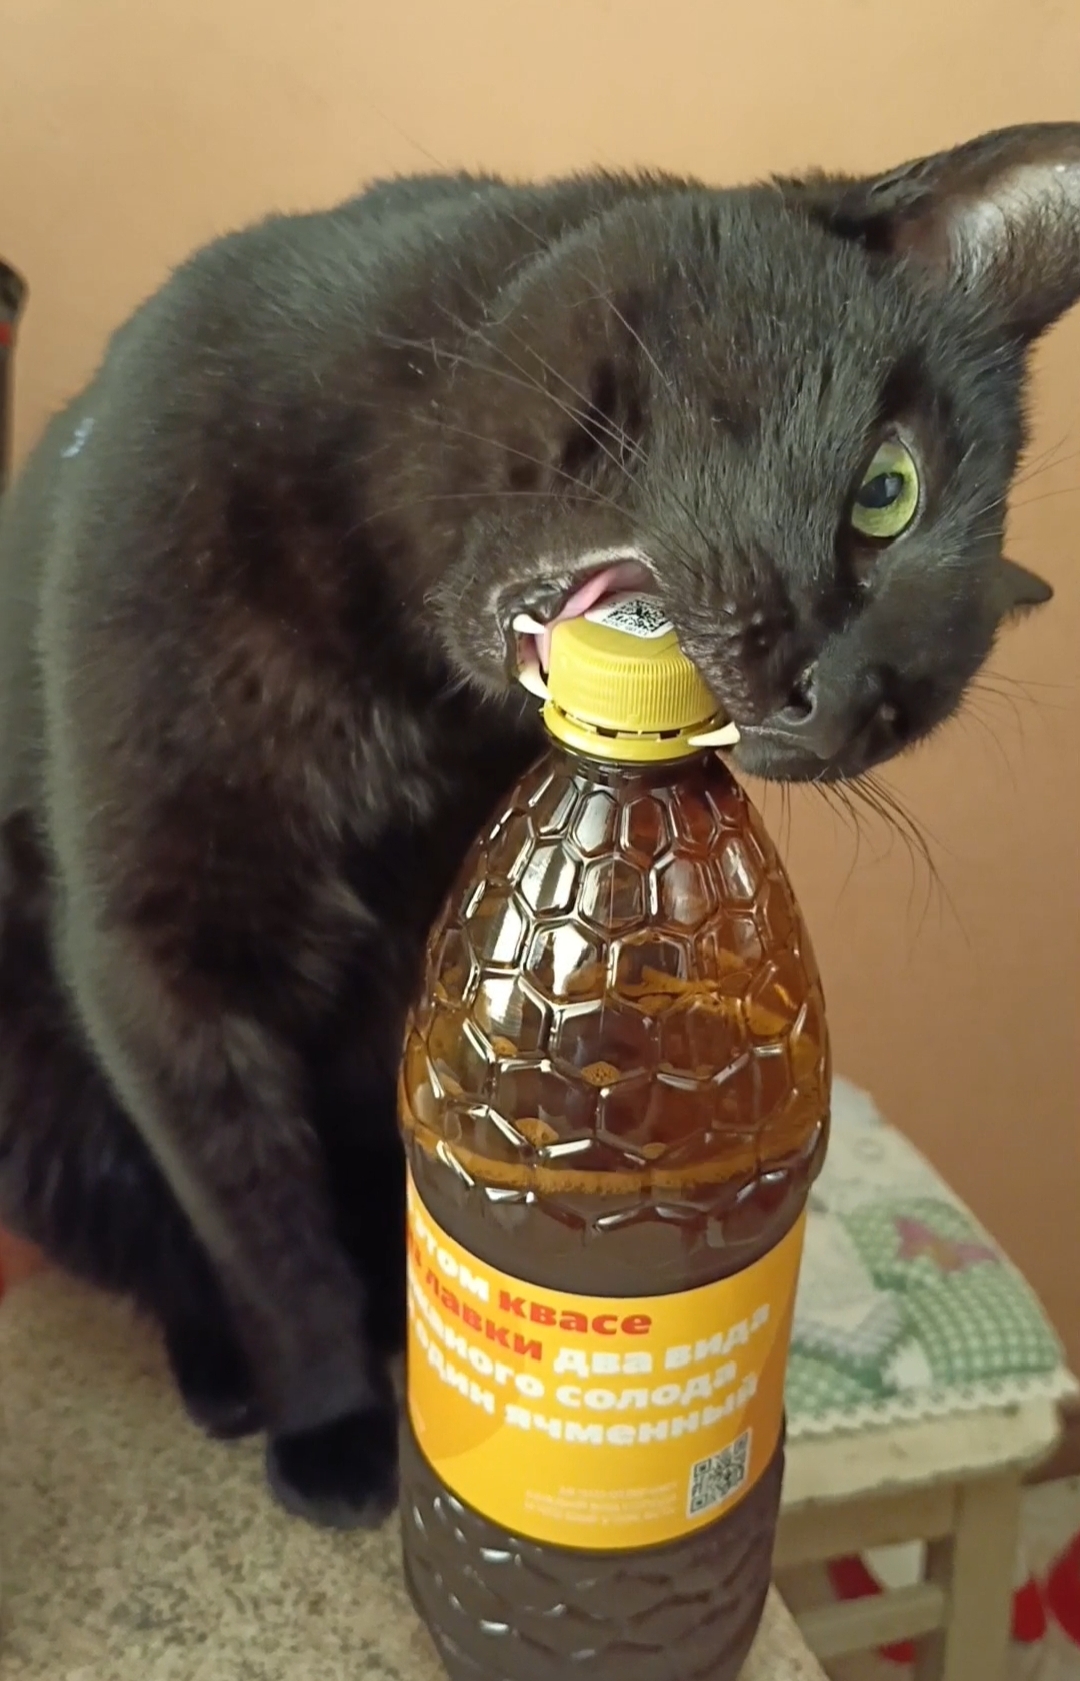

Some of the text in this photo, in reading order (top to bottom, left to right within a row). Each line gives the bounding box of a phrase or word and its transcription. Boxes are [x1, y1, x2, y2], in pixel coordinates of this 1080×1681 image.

[407, 1262, 546, 1398] аного
[556, 1360, 737, 1411] солода
[426, 1267, 543, 1361] лавки
[553, 1347, 653, 1379] два
[664, 1303, 771, 1370] вида
[499, 1290, 652, 1335] квасе
[504, 1371, 759, 1446] ячменный
